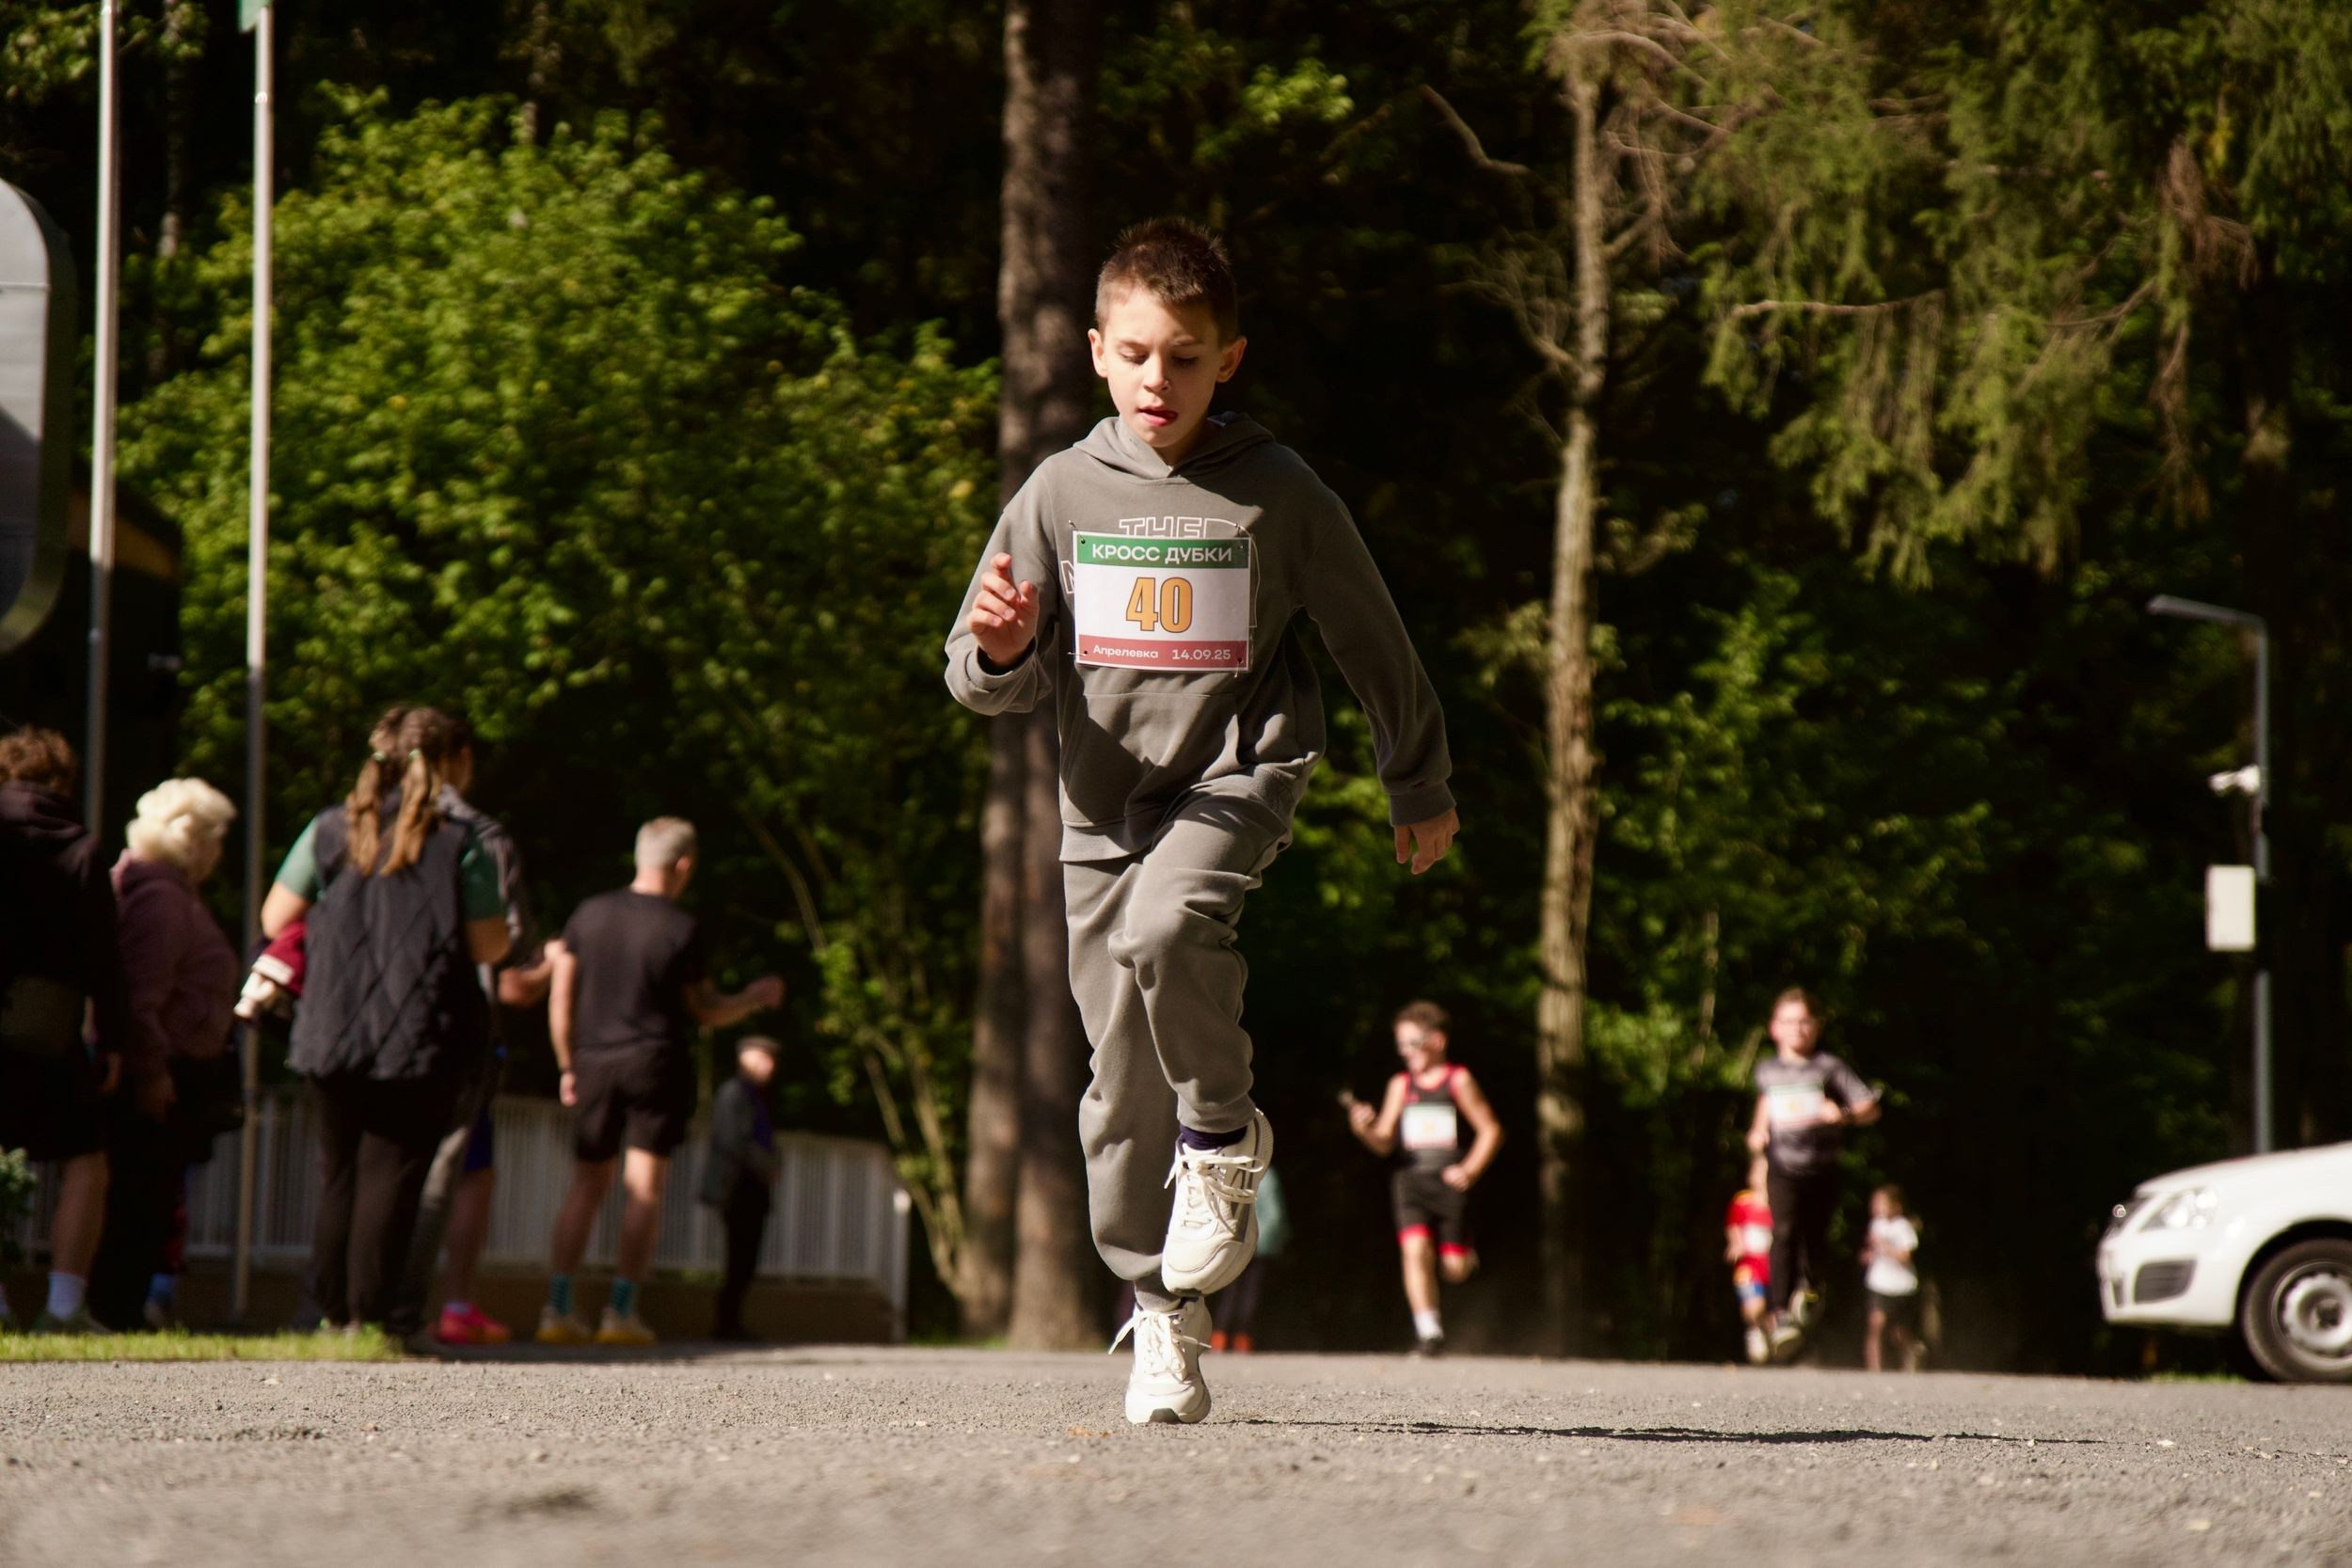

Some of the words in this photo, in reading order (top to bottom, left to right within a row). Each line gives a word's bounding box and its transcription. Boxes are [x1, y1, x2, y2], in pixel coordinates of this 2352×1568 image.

[1092, 544, 1161, 562] КРОСС
[1165, 546, 1232, 564] ДУБКИ
[1125, 577, 1193, 633] 40
[1092, 644, 1159, 660] Апрелевка
[1171, 649, 1232, 660] 14.09.25
